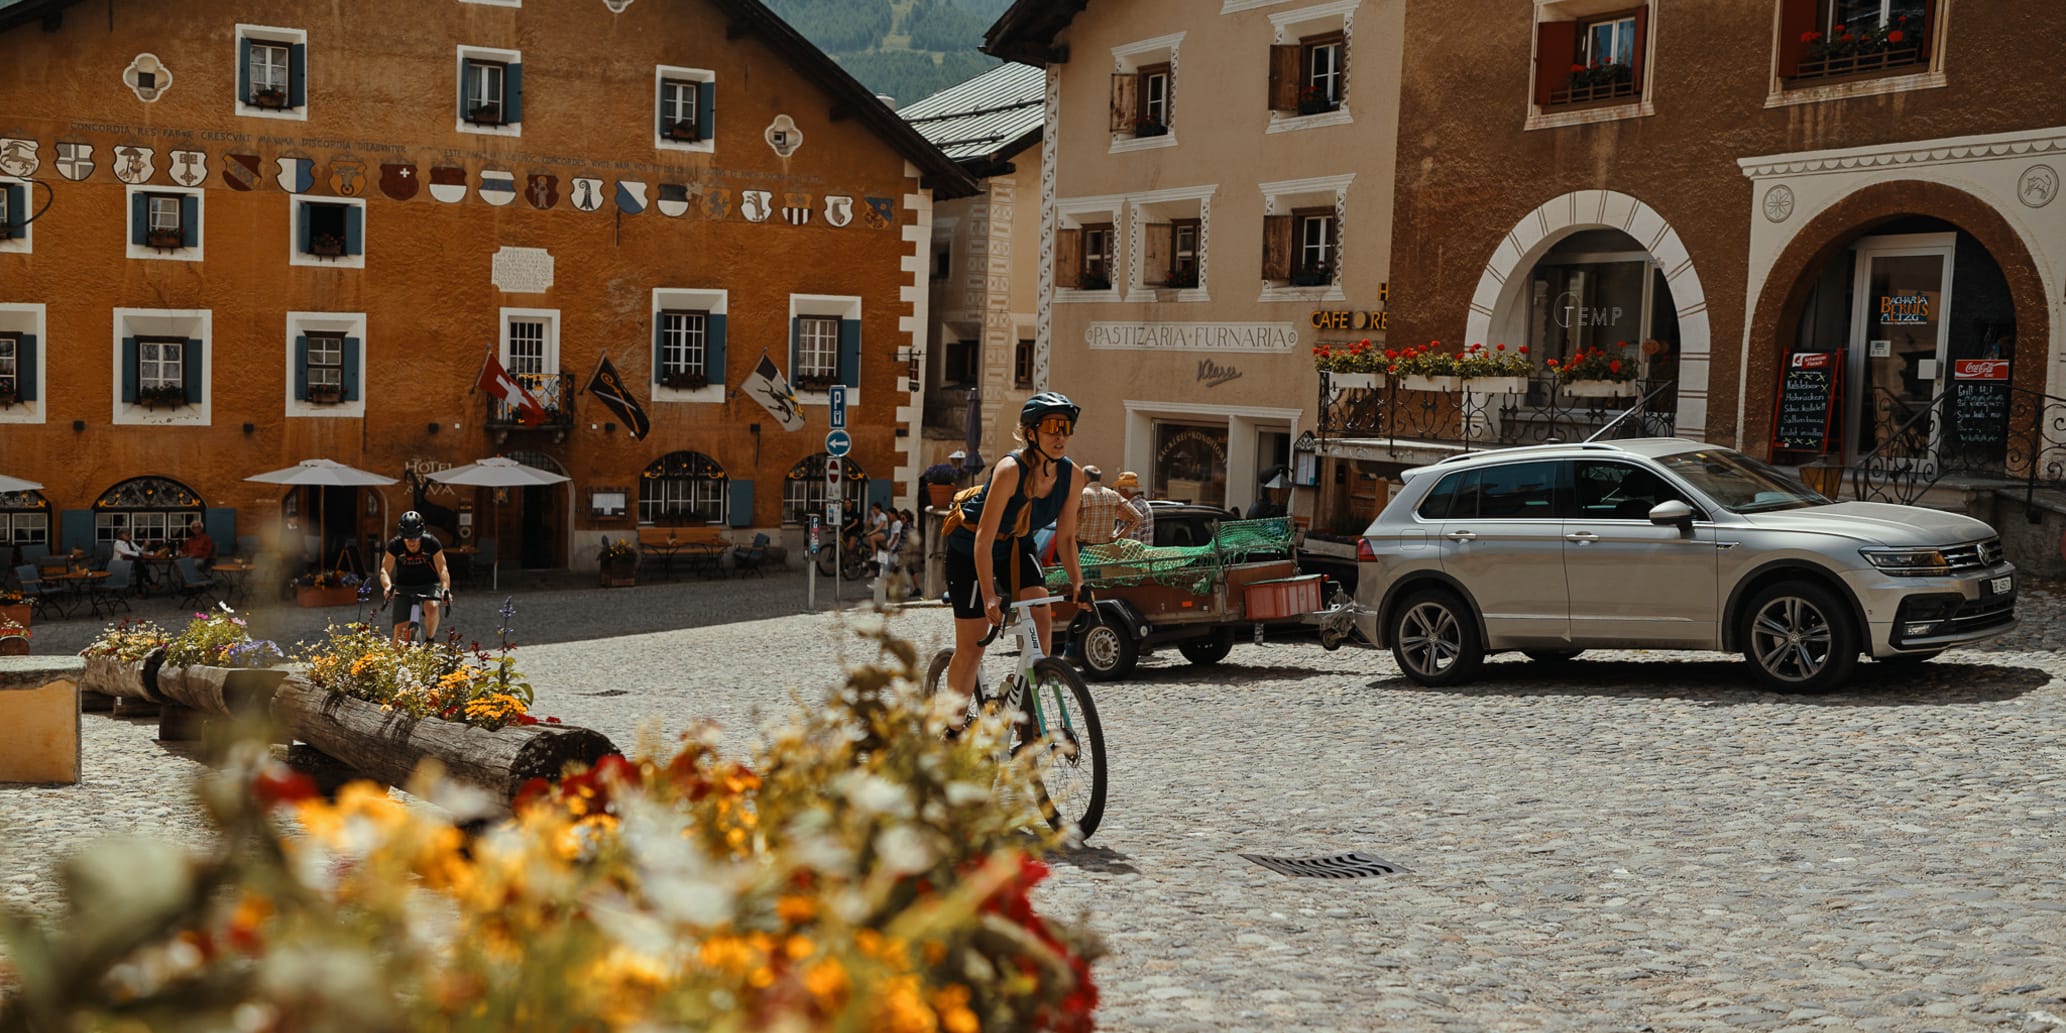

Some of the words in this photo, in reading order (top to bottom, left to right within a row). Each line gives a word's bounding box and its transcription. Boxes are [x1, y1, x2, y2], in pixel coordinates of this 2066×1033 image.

[71, 122, 130, 136] CONCORDIA
[1311, 311, 1349, 329] CAFE
[1093, 326, 1188, 346] PASTIZARIA
[1194, 327, 1287, 348] FURNARIA
[833, 391, 841, 410] P
